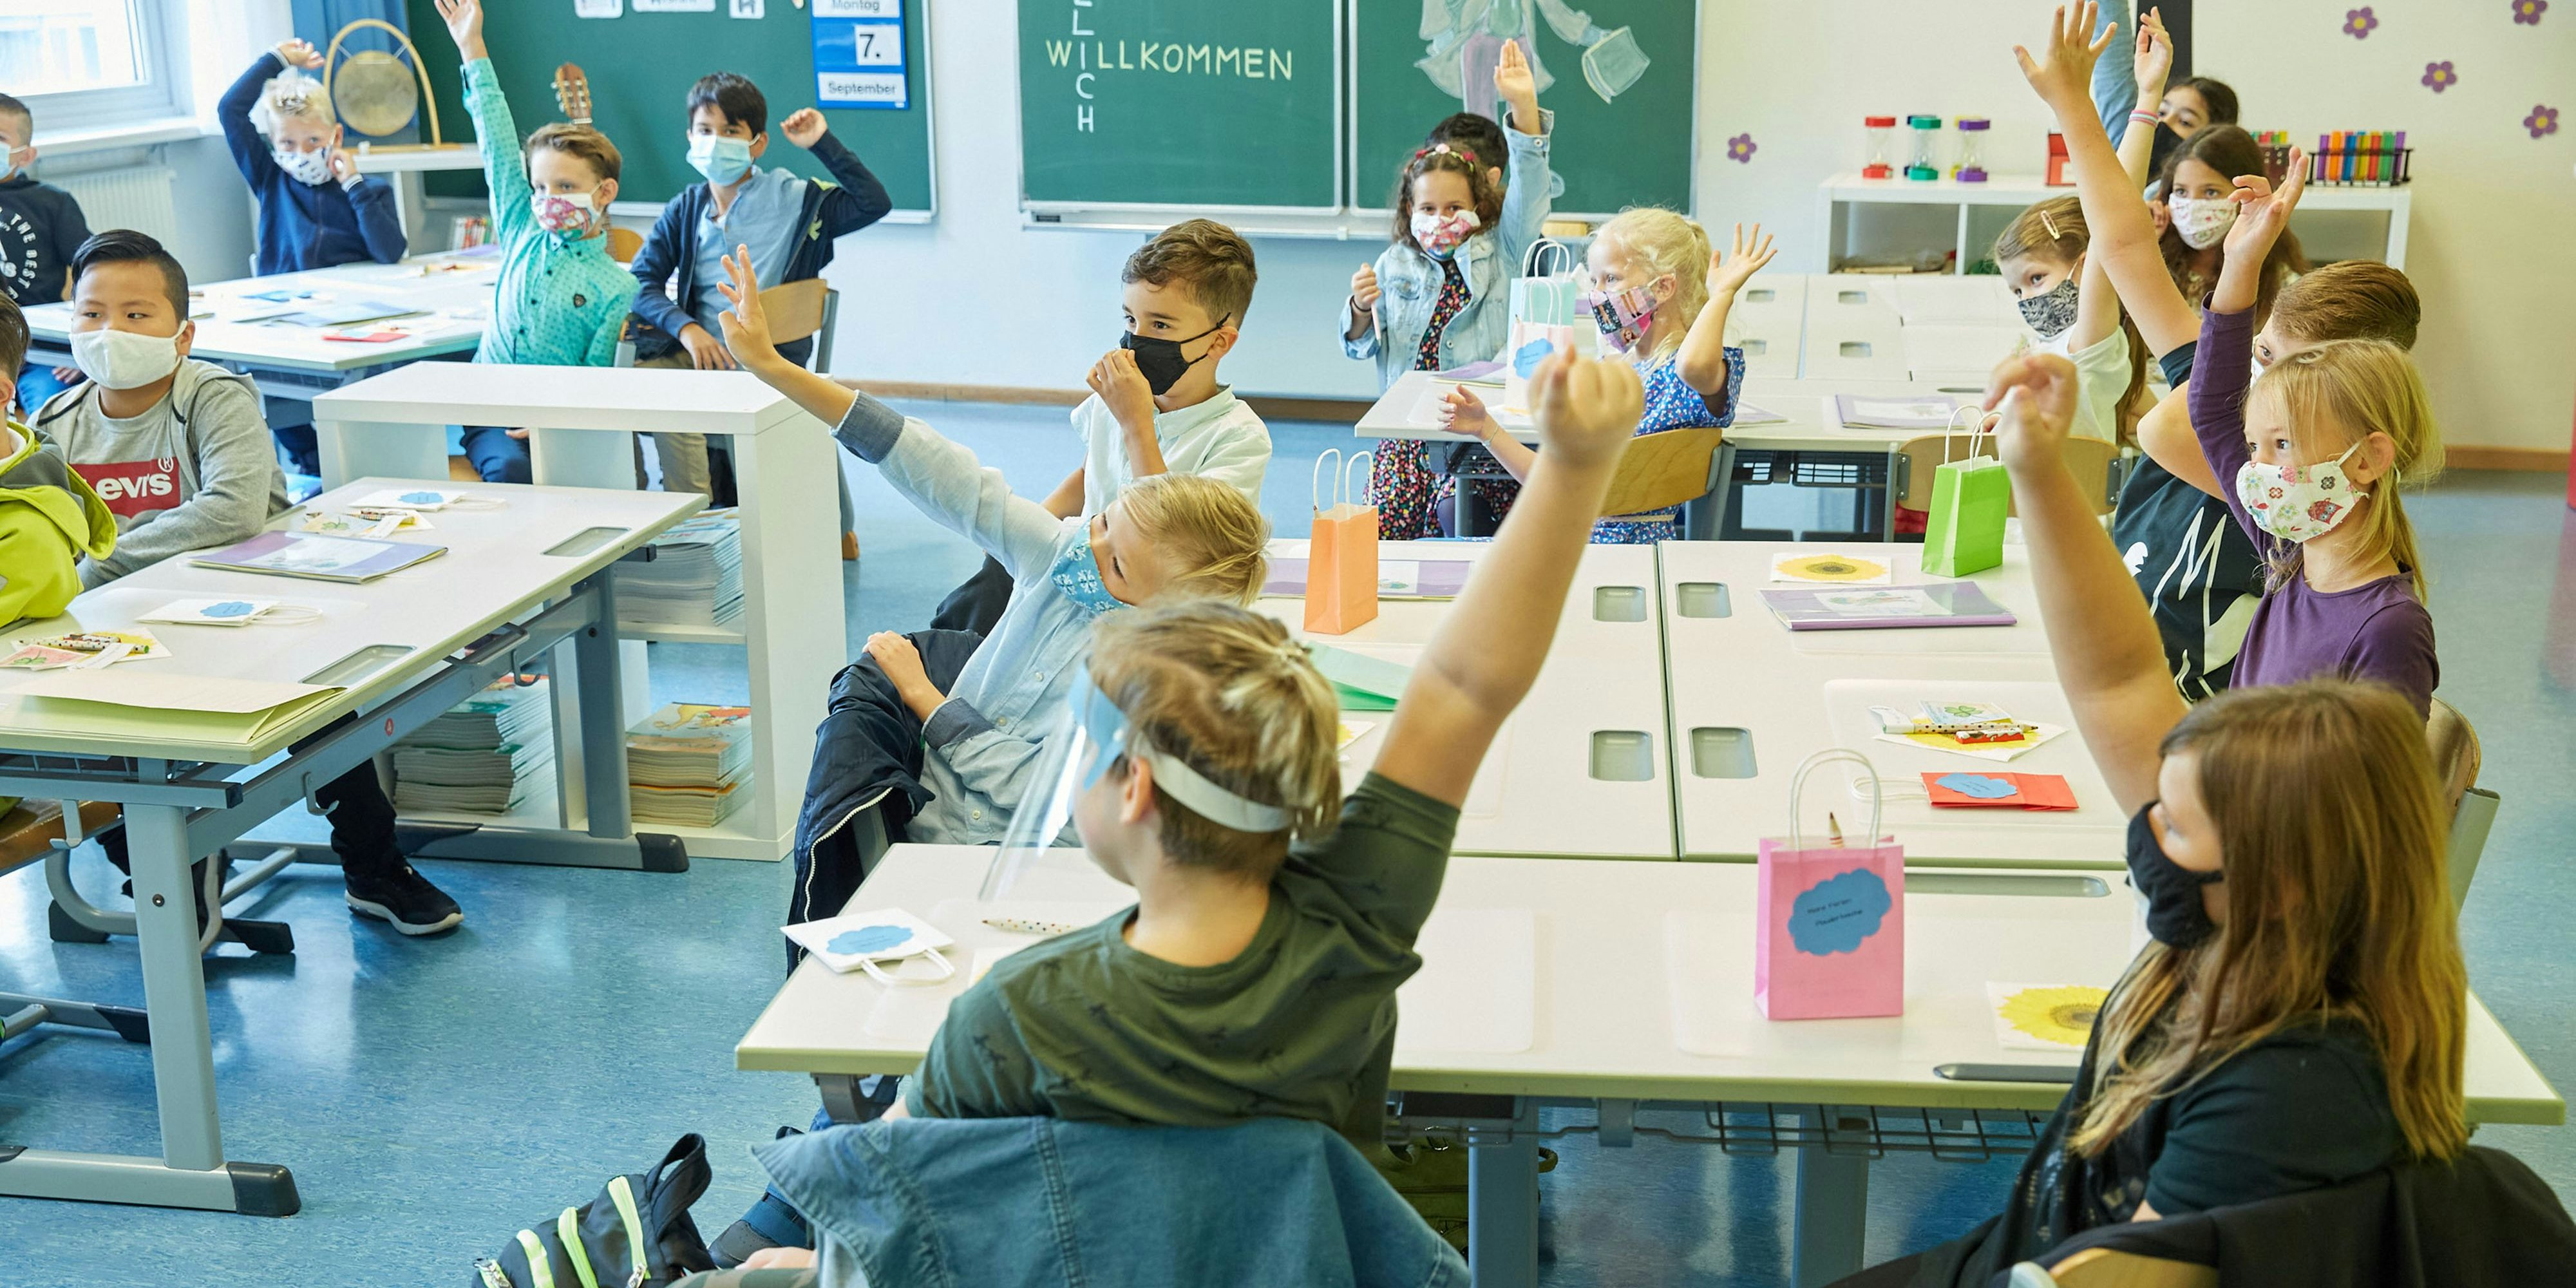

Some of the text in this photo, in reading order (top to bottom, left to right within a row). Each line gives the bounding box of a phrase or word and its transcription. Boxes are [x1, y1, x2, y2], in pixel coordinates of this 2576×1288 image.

[859, 33, 880, 57] 7.
[1045, 39, 1292, 80] WILLKOMMEN
[1072, 0, 1095, 133] LICH
[828, 81, 896, 95] September
[10, 213, 36, 243] THE
[17, 249, 37, 289] BEST
[84, 473, 173, 500] evi's
